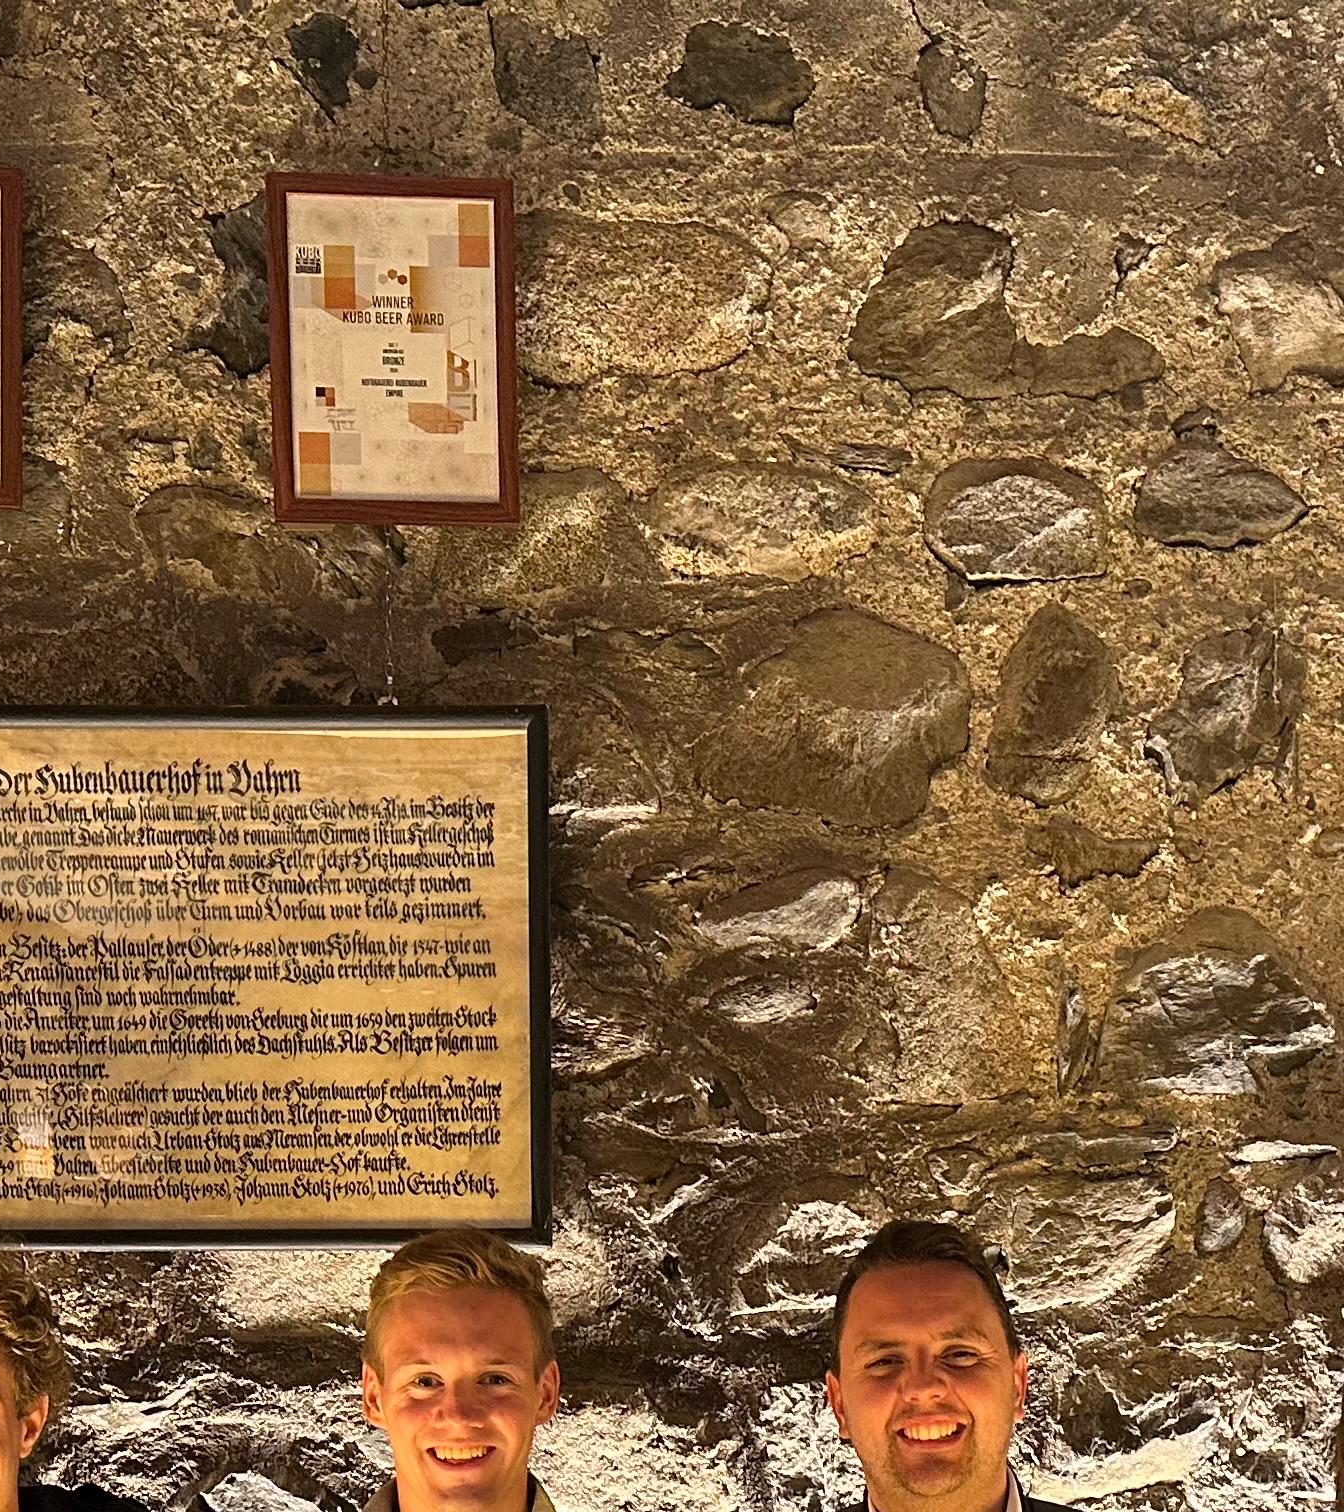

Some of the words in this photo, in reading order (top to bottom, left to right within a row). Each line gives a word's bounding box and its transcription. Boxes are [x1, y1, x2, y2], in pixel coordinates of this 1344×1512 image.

[372, 296, 413, 309] WINNER
[342, 311, 371, 324] KUBO
[375, 311, 403, 325] BEER
[406, 313, 444, 326] AWARD
[34, 758, 203, 800] Hubenbauerhof
[205, 764, 224, 795] in
[226, 758, 301, 797] Vahrn
[28, 800, 42, 822] in
[173, 803, 193, 821] um
[222, 803, 247, 821] war
[272, 803, 307, 827] gegen
[309, 799, 346, 821] Ende
[348, 798, 370, 821] des
[410, 799, 426, 819] im
[476, 794, 495, 819] der
[219, 823, 239, 846] des
[319, 822, 370, 846] Turmes
[391, 824, 407, 844] im
[46, 849, 146, 875] Treppenrampe
[149, 849, 173, 870] und
[266, 846, 316, 874] Keller
[476, 849, 495, 868] im
[16, 872, 63, 898] Gotik
[66, 873, 85, 897] im
[139, 873, 170, 899] zwei
[171, 870, 219, 902] Keller
[223, 873, 249, 895] mit
[250, 870, 342, 896] Tramdecken
[420, 870, 472, 894] wurden
[26, 898, 51, 923] das
[157, 899, 186, 921] über
[189, 898, 232, 921] Turm
[235, 898, 263, 921] und
[263, 895, 326, 922] Vorbau
[330, 902, 362, 920] war
[398, 896, 487, 924] gezimmert.
[67, 936, 88, 958] der
[166, 936, 188, 958] der
[277, 936, 299, 957] der
[301, 938, 327, 957] von
[389, 934, 408, 956] die
[473, 937, 491, 955] an
[122, 959, 141, 981] die
[253, 960, 280, 981] mit
[337, 956, 396, 985] errichtet
[439, 954, 497, 985] Spuren
[106, 986, 137, 1009] noch
[139, 983, 240, 1008] wahrnehmbar.
[4, 1010, 23, 1031] die
[92, 1013, 115, 1031] um
[117, 1015, 147, 1032] 1649
[150, 1007, 168, 1031] die
[226, 1013, 250, 1031] von
[310, 1007, 329, 1030] die
[331, 1010, 354, 1030] um
[356, 1011, 383, 1031] 1659
[385, 1006, 406, 1029] den
[408, 1007, 453, 1034] zweiten
[109, 1032, 150, 1058] haben,
[234, 1030, 256, 1054] des
[338, 1028, 368, 1054] Als
[476, 1034, 499, 1052] um
[225, 1079, 258, 1102] blieb
[262, 1080, 282, 1101] der
[282, 1076, 390, 1104] Hubenbauerhof
[465, 1075, 502, 1103] Jahre
[202, 1105, 224, 1126] der
[225, 1105, 259, 1130] auch
[260, 1104, 284, 1125] den
[151, 1128, 202, 1152] Urban
[203, 1127, 240, 1153] Stolz
[243, 1132, 263, 1150] aus
[355, 1126, 401, 1152] obwohl
[401, 1134, 413, 1147] er
[414, 1127, 432, 1147] die
[185, 1152, 211, 1174] und
[213, 1152, 237, 1174] den
[364, 1150, 411, 1175] kaufte.
[24, 1177, 62, 1202] Stolz
[99, 1178, 156, 1207] Johann
[154, 1176, 192, 1203] Stolz
[234, 1175, 291, 1206] Johann
[291, 1174, 332, 1203] Stolz
[378, 1174, 405, 1196] und
[406, 1171, 453, 1199] Erich
[452, 1169, 499, 1200] Stolz.
